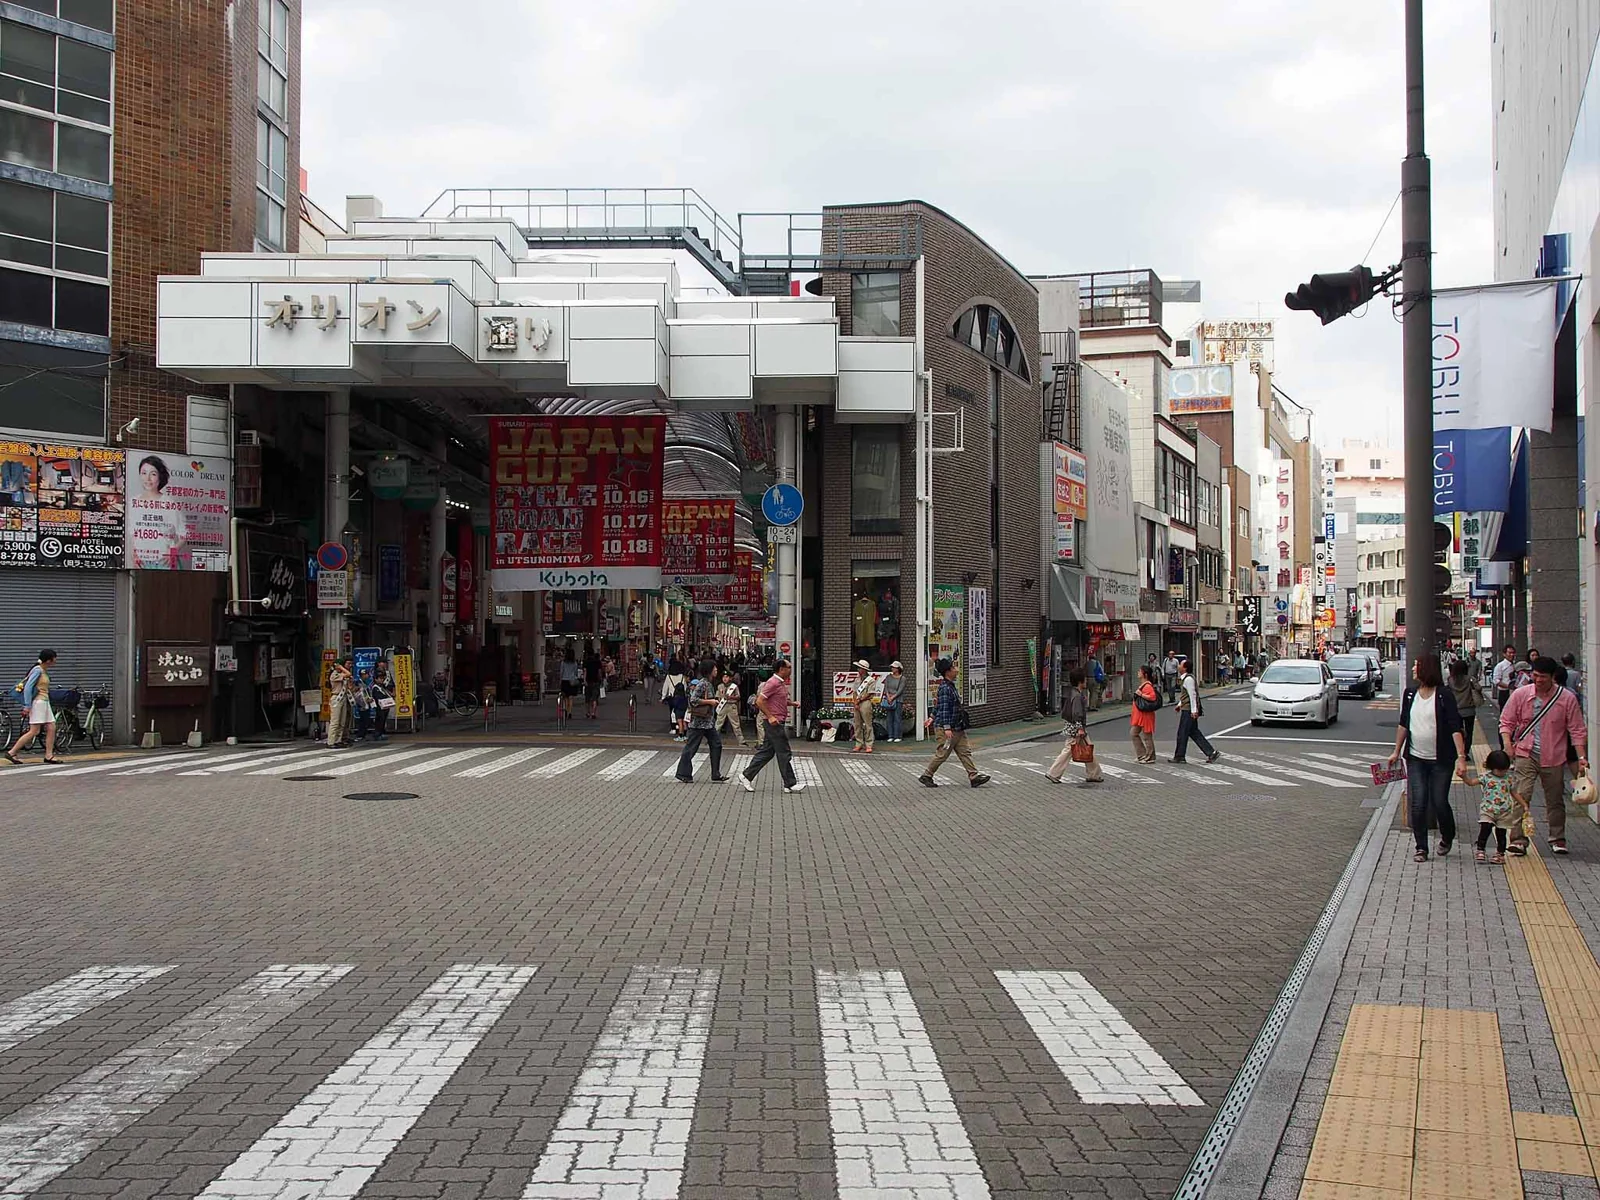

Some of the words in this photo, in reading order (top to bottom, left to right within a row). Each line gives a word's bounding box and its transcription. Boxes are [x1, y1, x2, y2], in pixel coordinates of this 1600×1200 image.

[497, 428, 656, 455] JAPAN
[170, 470, 194, 478] COLOR
[200, 472, 225, 480] DREAM
[496, 457, 588, 484] CUP
[1433, 441, 1454, 505] TOBU
[495, 485, 597, 507] CYCLE
[602, 490, 649, 504] 10.16
[495, 508, 584, 532] ROAD
[602, 514, 648, 528] 10.17
[63, 544, 122, 555] GRASSINO
[495, 531, 582, 555] RACE
[601, 539, 648, 553] 10.18
[507, 555, 581, 564] UTSUNOMIYA
[540, 571, 608, 586] Kubota
[158, 652, 194, 666] 焼とり
[164, 667, 202, 682] かしわ
